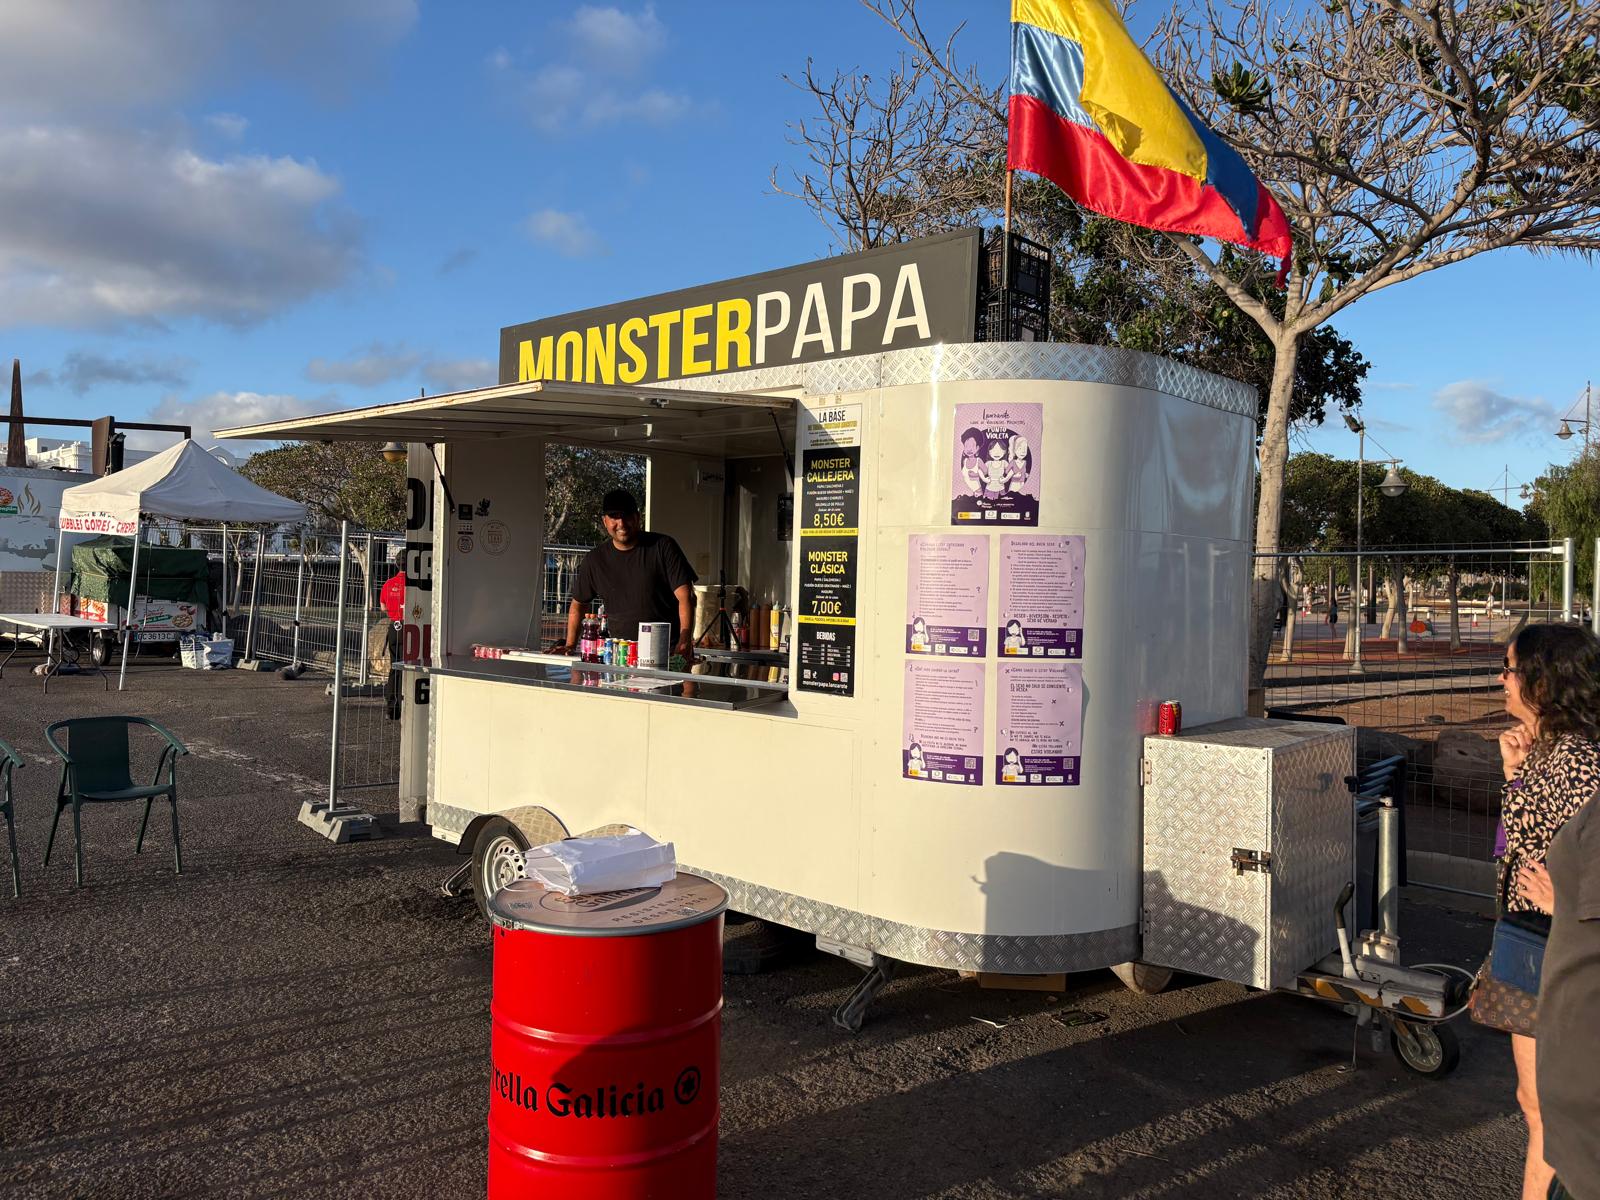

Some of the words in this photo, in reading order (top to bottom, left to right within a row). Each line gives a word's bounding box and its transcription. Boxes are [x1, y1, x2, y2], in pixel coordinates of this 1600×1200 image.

[828, 409, 846, 422] BASE
[985, 432, 1009, 440] VIOLETA
[811, 458, 850, 470] MONSTER
[806, 470, 855, 483] CALLEJERA
[813, 512, 845, 529] 8,50€
[808, 551, 848, 563] MONSTER
[810, 561, 846, 575] CLÁSICA
[811, 601, 842, 616] 7,00€
[816, 631, 836, 642] BEBIDAS
[415, 678, 431, 704] 6
[545, 1082, 665, 1119] Galicia
